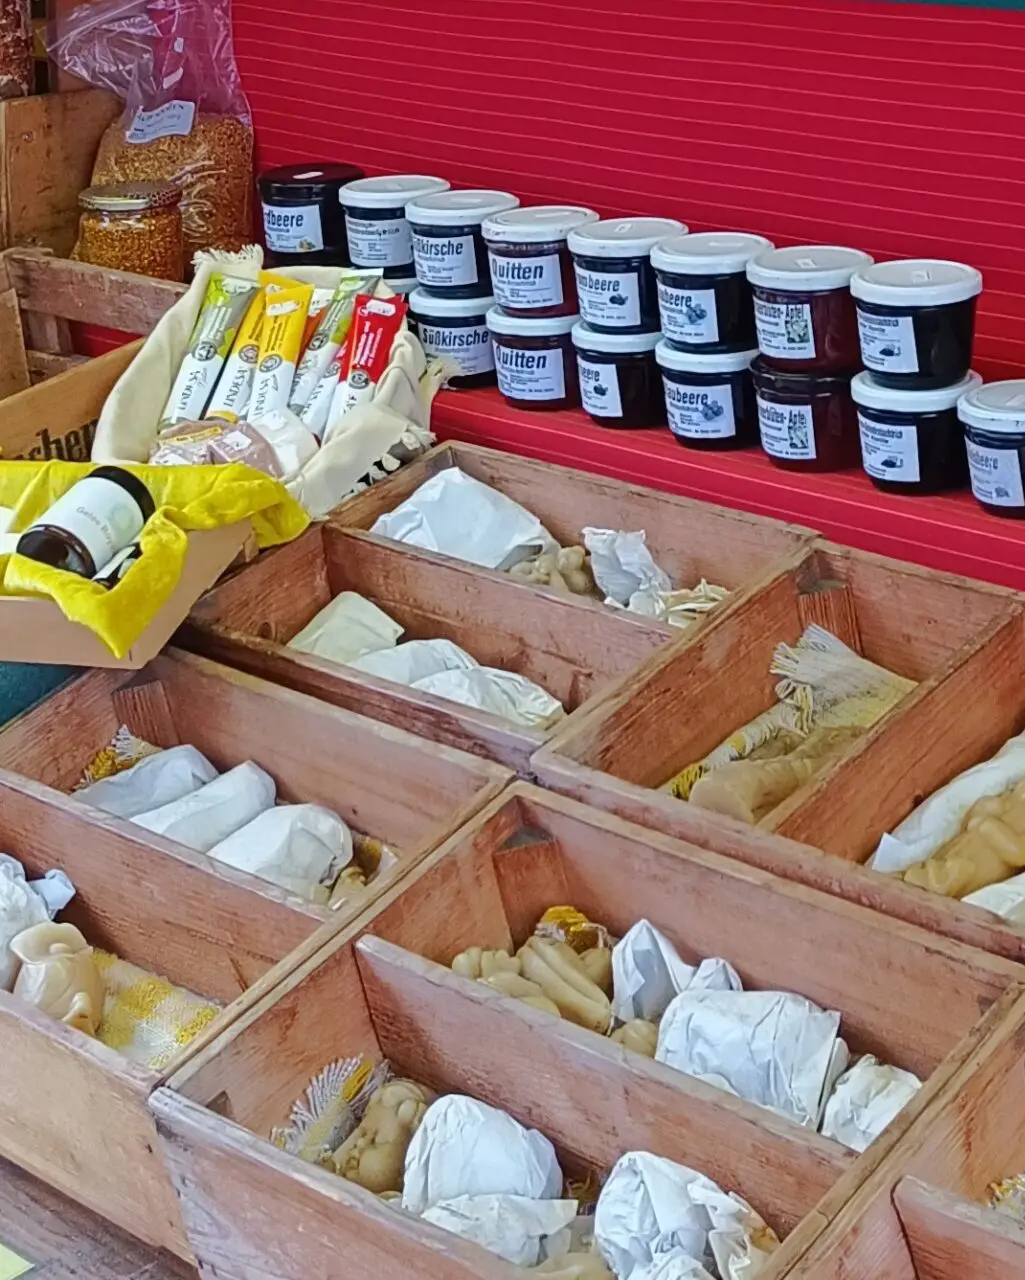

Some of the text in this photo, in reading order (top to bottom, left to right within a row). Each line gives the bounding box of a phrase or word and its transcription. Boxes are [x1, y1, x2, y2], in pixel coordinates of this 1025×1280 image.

[263, 209, 305, 230] dbeere
[417, 239, 465, 259] ßkirsche
[490, 257, 545, 282] Quitten
[421, 328, 490, 348] Süßkirsche
[495, 344, 548, 371] Quitten
